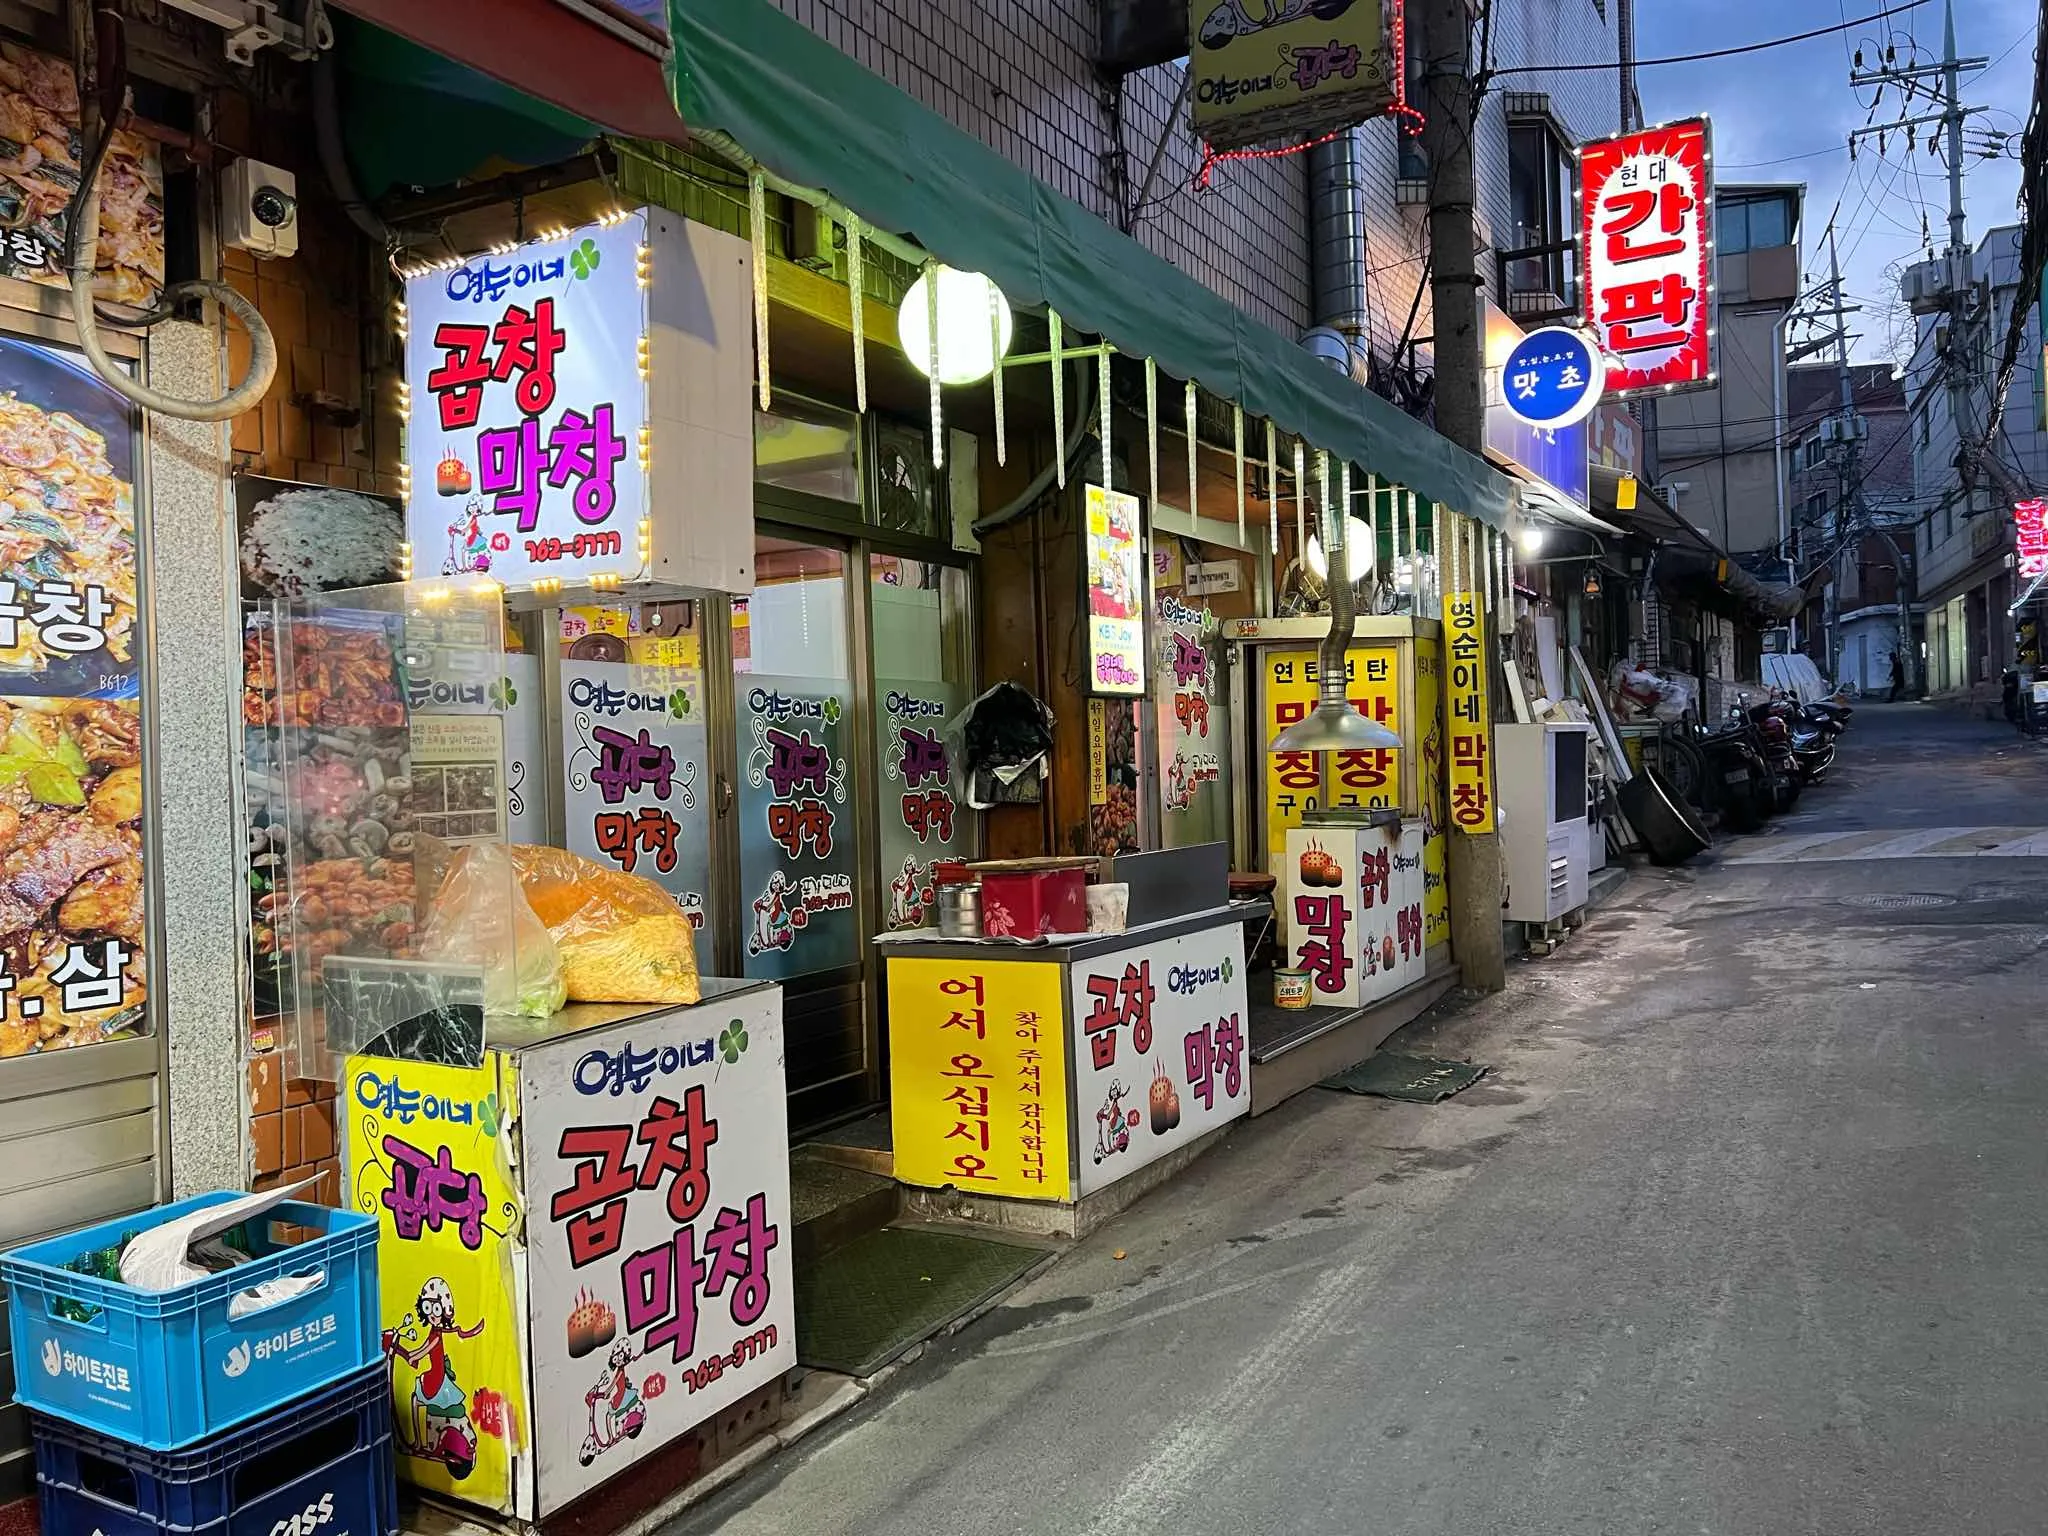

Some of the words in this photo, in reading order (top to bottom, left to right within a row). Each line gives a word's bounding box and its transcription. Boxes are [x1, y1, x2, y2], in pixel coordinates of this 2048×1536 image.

[0, 229, 46, 268] 창
[1602, 182, 1695, 355] 간판
[428, 297, 565, 431] 곱창
[477, 403, 626, 532] 막창
[524, 532, 622, 563] 762-3777
[1450, 600, 1481, 723] 영순이네
[902, 790, 955, 843] 막창
[1453, 734, 1488, 826] 막창
[595, 807, 681, 873] 막창
[767, 798, 835, 859] 막창
[1361, 846, 1390, 909] 곱창
[1294, 895, 1353, 994] 막창
[1397, 902, 1422, 962] 막창
[0, 940, 131, 1020] .삼
[939, 975, 985, 1040] 어서
[1085, 959, 1155, 1071] 곱창
[1015, 1011, 1042, 1043] 찾아
[1184, 1013, 1244, 1111] 막창
[1016, 1049, 1043, 1097] 주셔서
[940, 1053, 998, 1181] 오십시오
[1018, 1103, 1048, 1184] 감사합니다
[551, 1084, 718, 1269] 곱창
[621, 1192, 778, 1364] 막창
[63, 1350, 131, 1392] 하이트진로
[255, 1314, 336, 1359] 하이트진로
[682, 1325, 777, 1395] 762-3777
